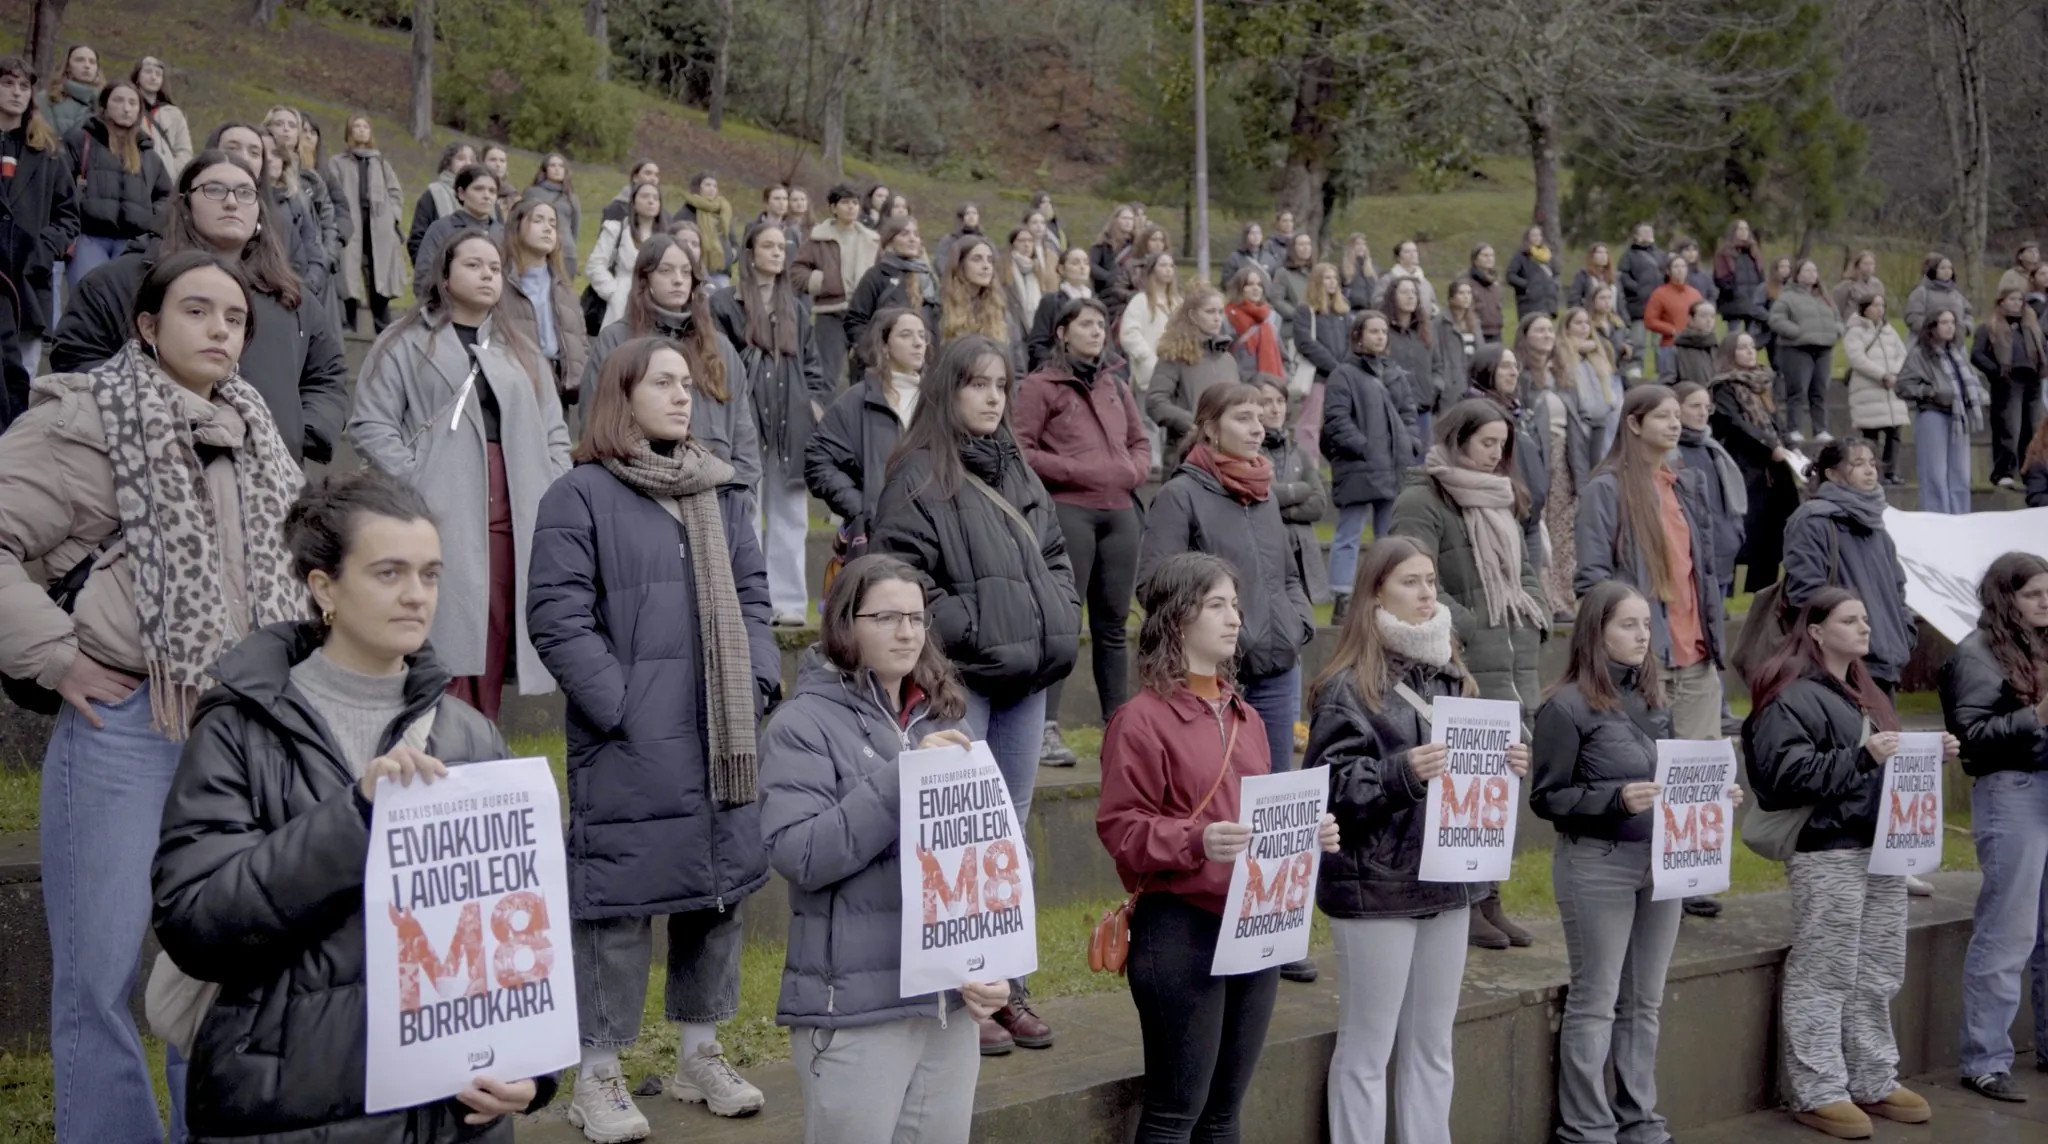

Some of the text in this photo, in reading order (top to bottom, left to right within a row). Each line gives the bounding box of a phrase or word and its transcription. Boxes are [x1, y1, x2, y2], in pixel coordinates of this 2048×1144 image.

[1445, 727, 1511, 751] EMAKUME
[1449, 752, 1508, 776] ANGILEOK
[1666, 763, 1729, 785] EMAKUME
[388, 791, 529, 823] MATXISMOAREN AURREAN
[919, 777, 1006, 820] EMAKUME
[1440, 771, 1509, 828] M8
[1663, 784, 1724, 804] LANGILEOK
[1889, 788, 1937, 835] M8
[387, 807, 536, 868] EMAKUME
[920, 808, 1012, 852] LANGILEOK
[1252, 799, 1321, 834] EMAKUME
[1438, 826, 1505, 847] BORROKARA
[1661, 801, 1724, 854] M8
[1248, 826, 1317, 859] LANGILEOK
[1663, 847, 1722, 870] BORROKARA
[392, 850, 540, 912] LANGILEOK
[916, 839, 1022, 924] M8
[1240, 850, 1313, 918] M8
[922, 905, 1024, 950] BORROKARA
[1235, 905, 1304, 939] BORROKARA
[388, 890, 555, 1012] M8
[400, 977, 555, 1046] BORROKARA
